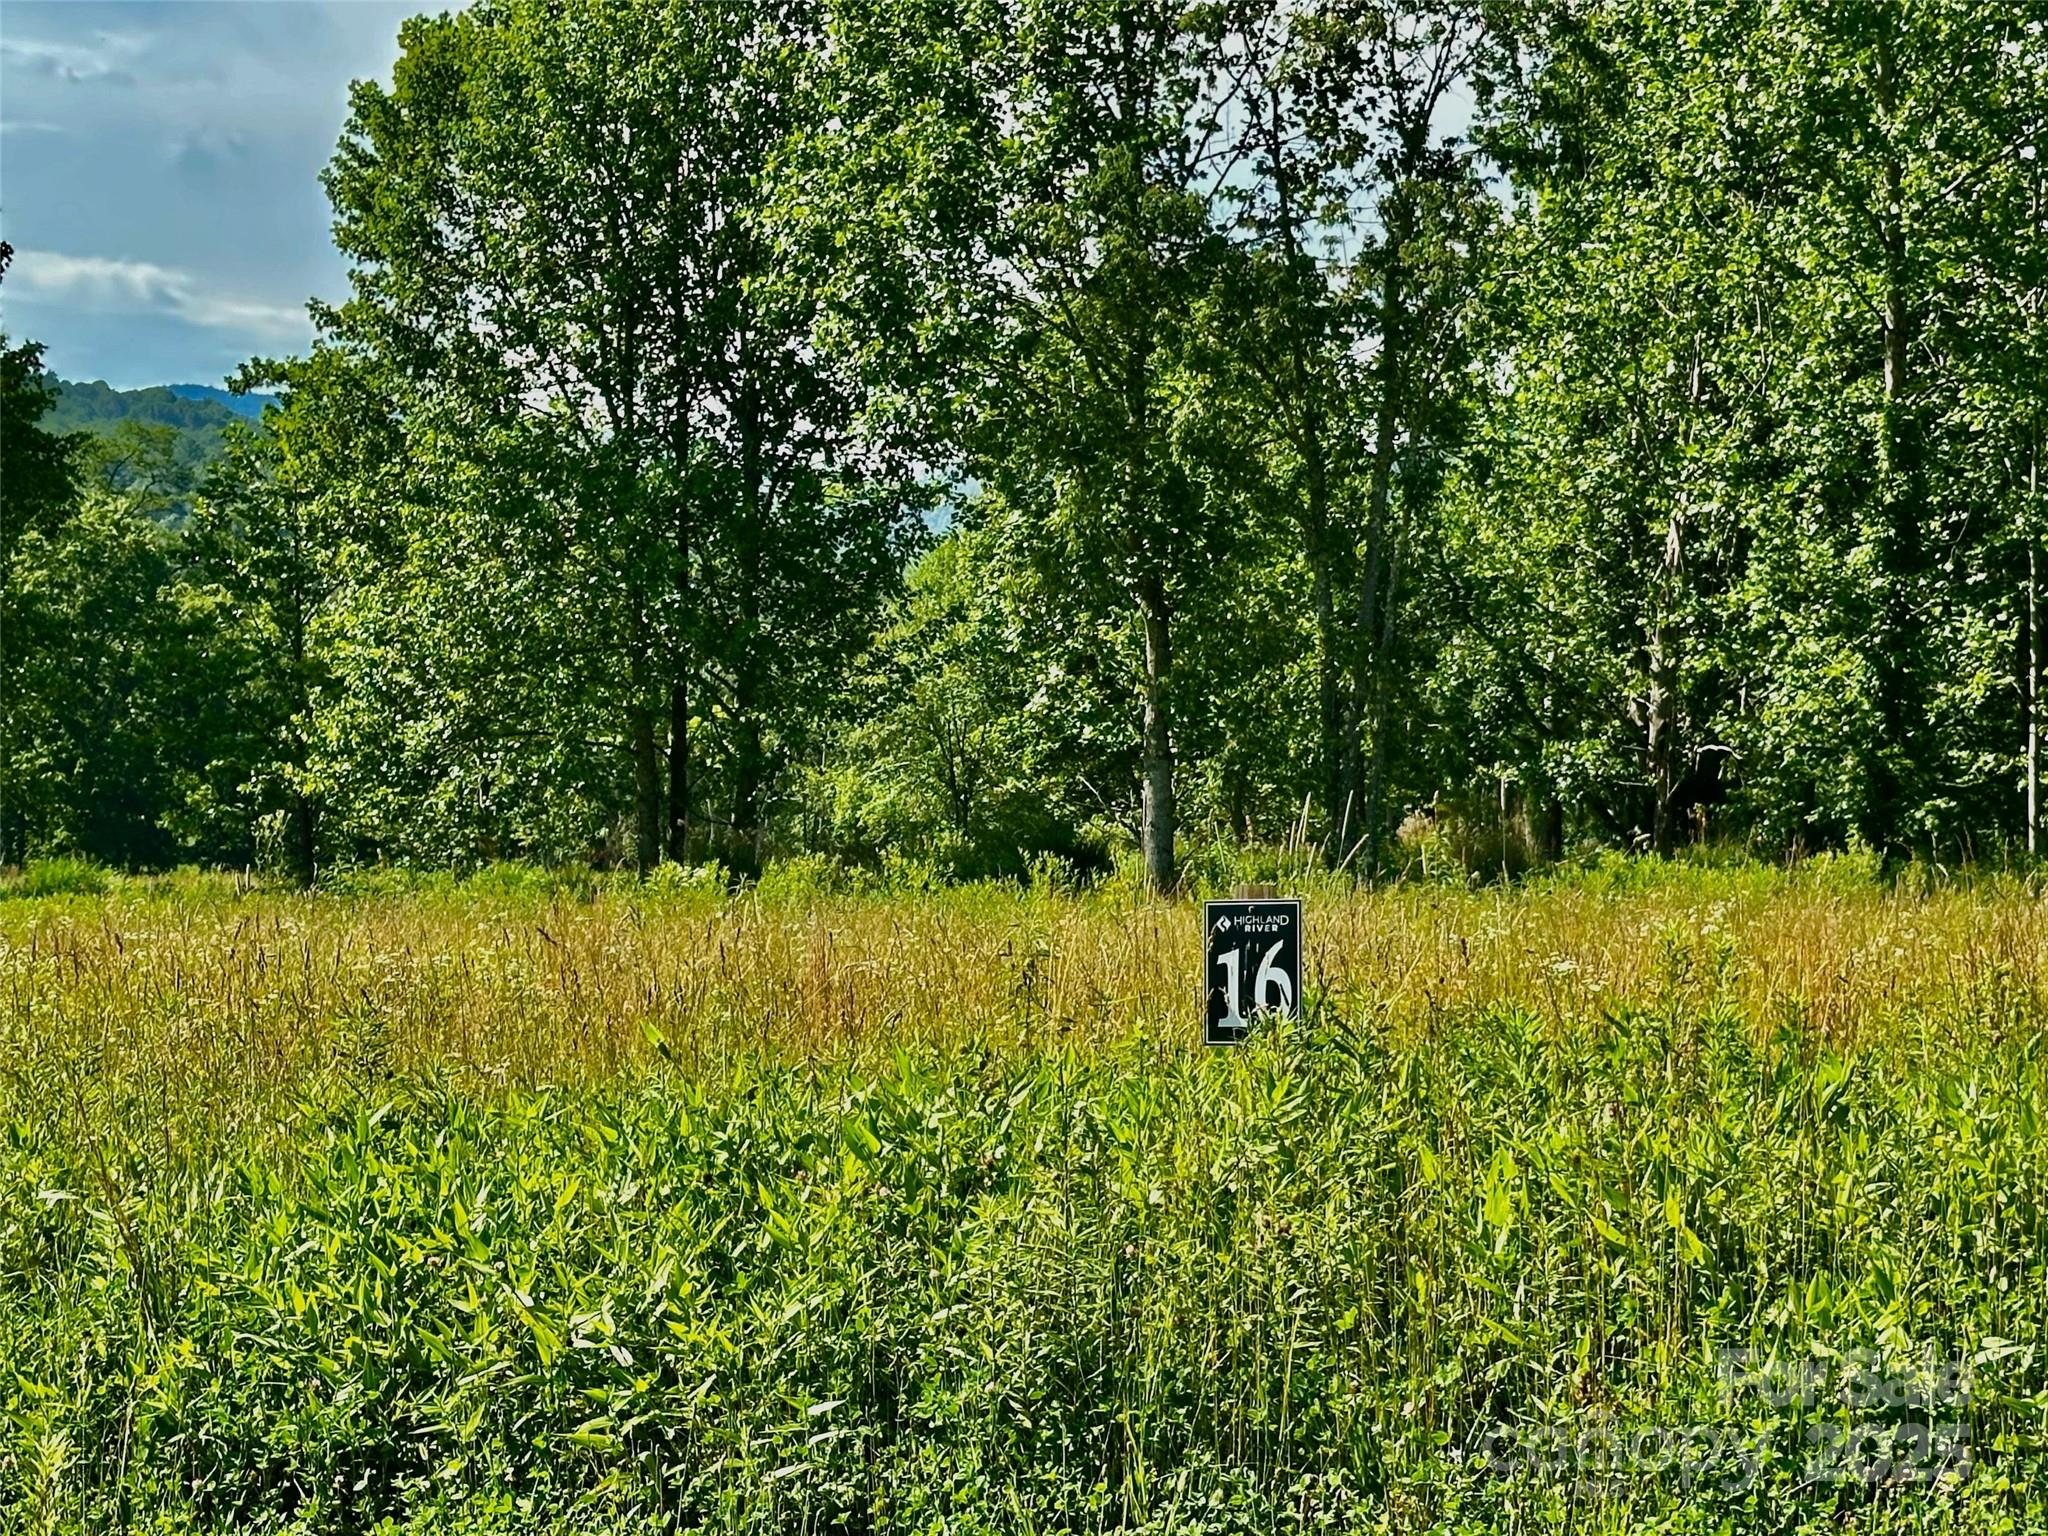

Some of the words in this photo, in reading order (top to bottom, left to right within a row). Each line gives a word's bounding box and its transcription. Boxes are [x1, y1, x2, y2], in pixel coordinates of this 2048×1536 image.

[1234, 915, 1289, 926] HIGHLAND
[1244, 924, 1279, 932] RIVER
[1216, 939, 1292, 1028] 16
